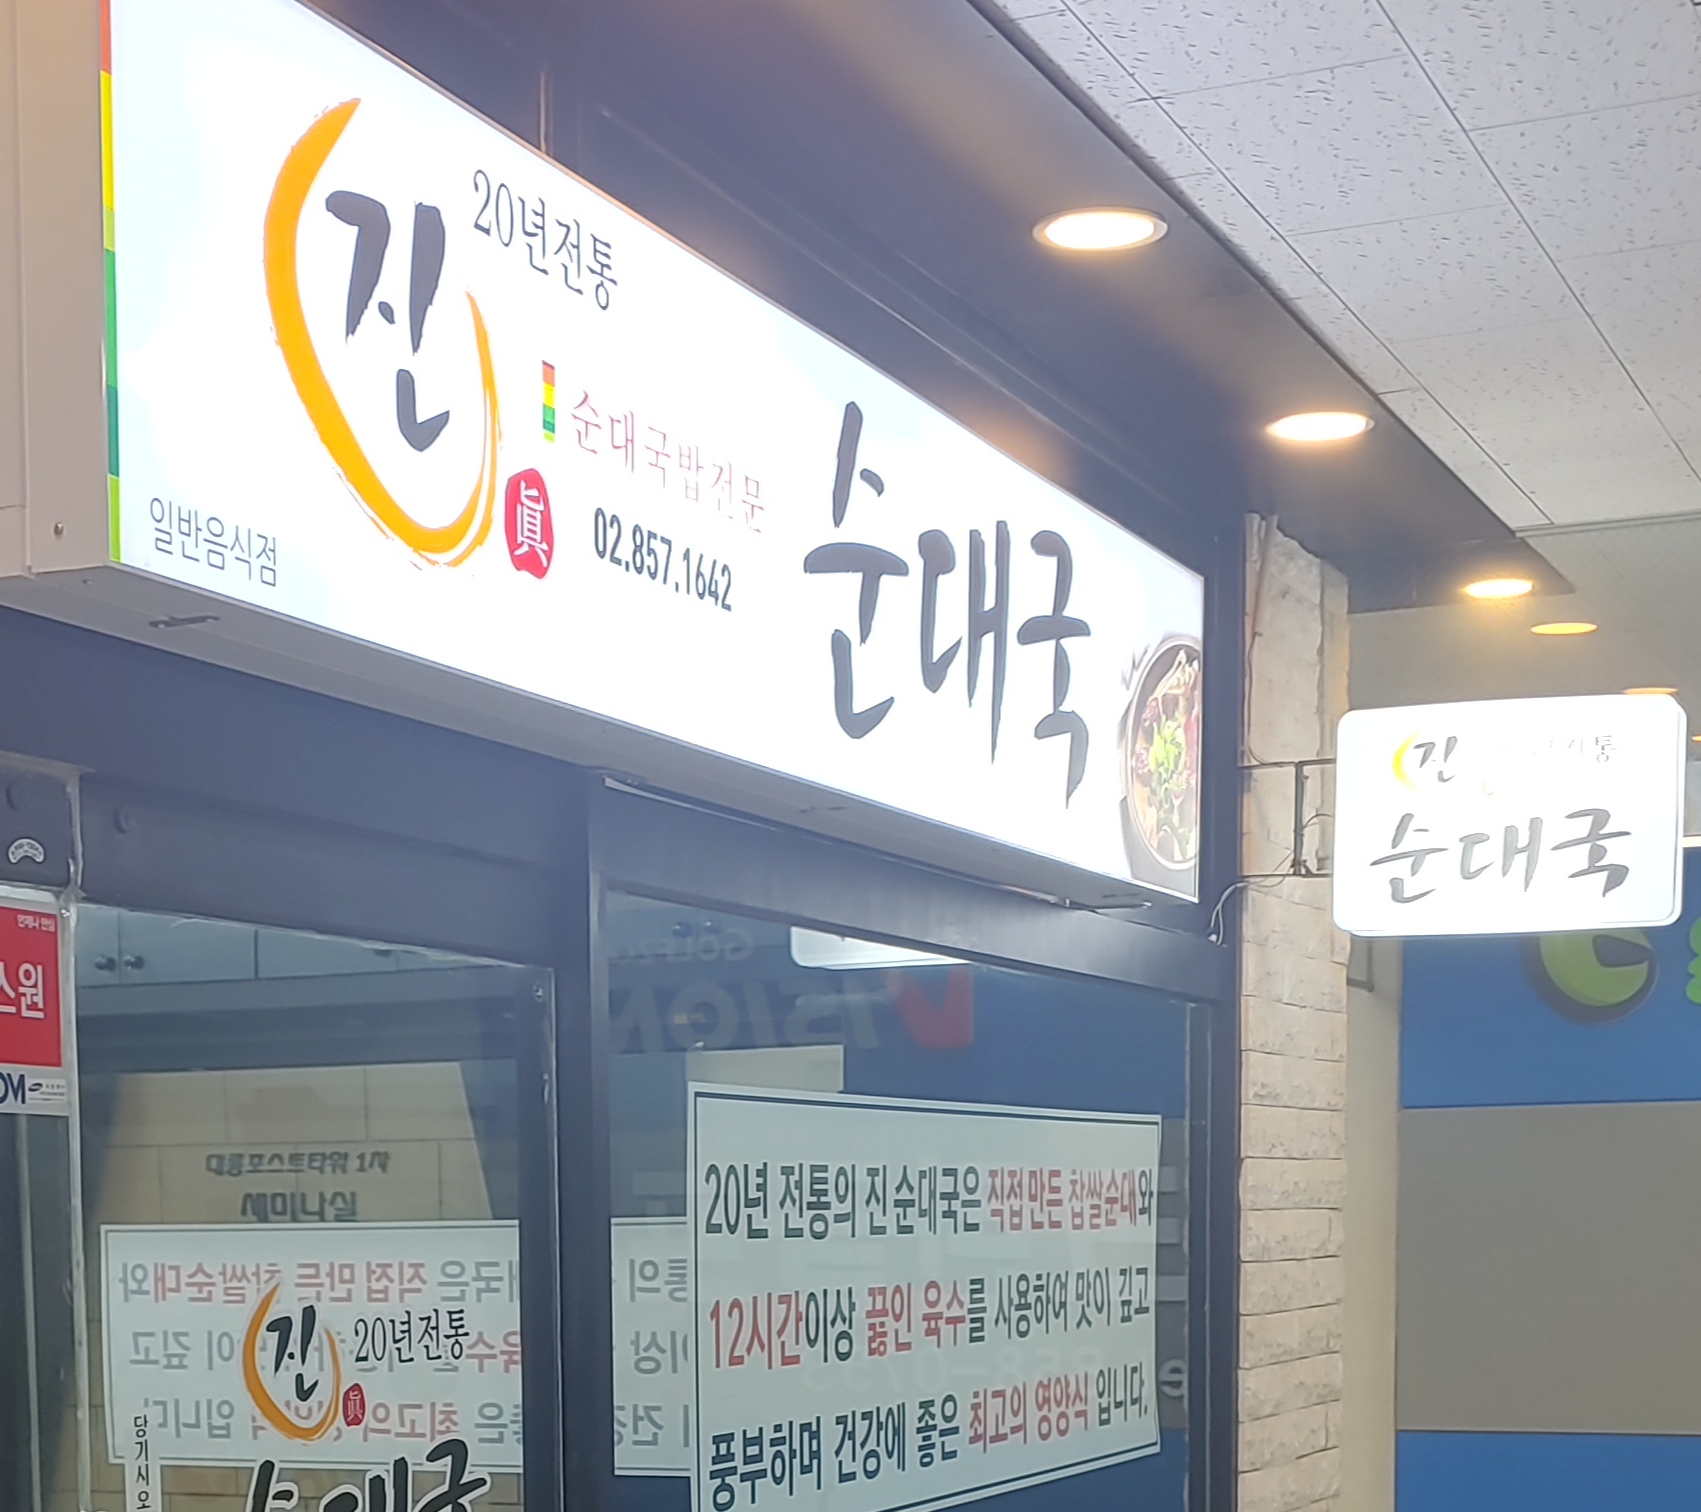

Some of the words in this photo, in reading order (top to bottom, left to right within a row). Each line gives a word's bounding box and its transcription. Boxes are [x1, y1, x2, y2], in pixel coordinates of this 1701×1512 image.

[473, 169, 618, 311] 20년전통
[325, 190, 450, 452] 진
[571, 389, 765, 533] 순대국밥전문
[150, 497, 277, 588] 일반음식점
[594, 507, 732, 612] 02.857.1642
[803, 400, 1092, 810] 순대국
[1413, 735, 1458, 783] 진
[1369, 807, 1632, 904] 순대국
[240, 1191, 358, 1223] 세미나실
[704, 1162, 769, 1239] 20년
[778, 1162, 856, 1240] 전통의
[893, 1164, 982, 1236] 순대국은
[987, 1166, 1024, 1233] 직접
[1028, 1167, 1064, 1230] 만든
[1068, 1167, 1154, 1231] 찹쌀순대와
[266, 1304, 319, 1402] 진
[354, 1307, 471, 1364] 20년전통
[709, 1285, 856, 1370] 12시간이상
[865, 1281, 912, 1358] 끓인
[921, 1277, 987, 1349] 육수를
[994, 1270, 1069, 1340] 사용하여
[1075, 1267, 1111, 1331] 맛이
[1118, 1265, 1150, 1324] 깊고
[133, 1413, 152, 1510] 당기시오
[708, 1415, 822, 1512] 풍부하며
[833, 1402, 906, 1485] 건강에
[915, 1393, 960, 1469] 좋은
[968, 1381, 1027, 1454] 최고의
[1034, 1370, 1089, 1442] 영양식
[1096, 1361, 1148, 1428] 입니다.
